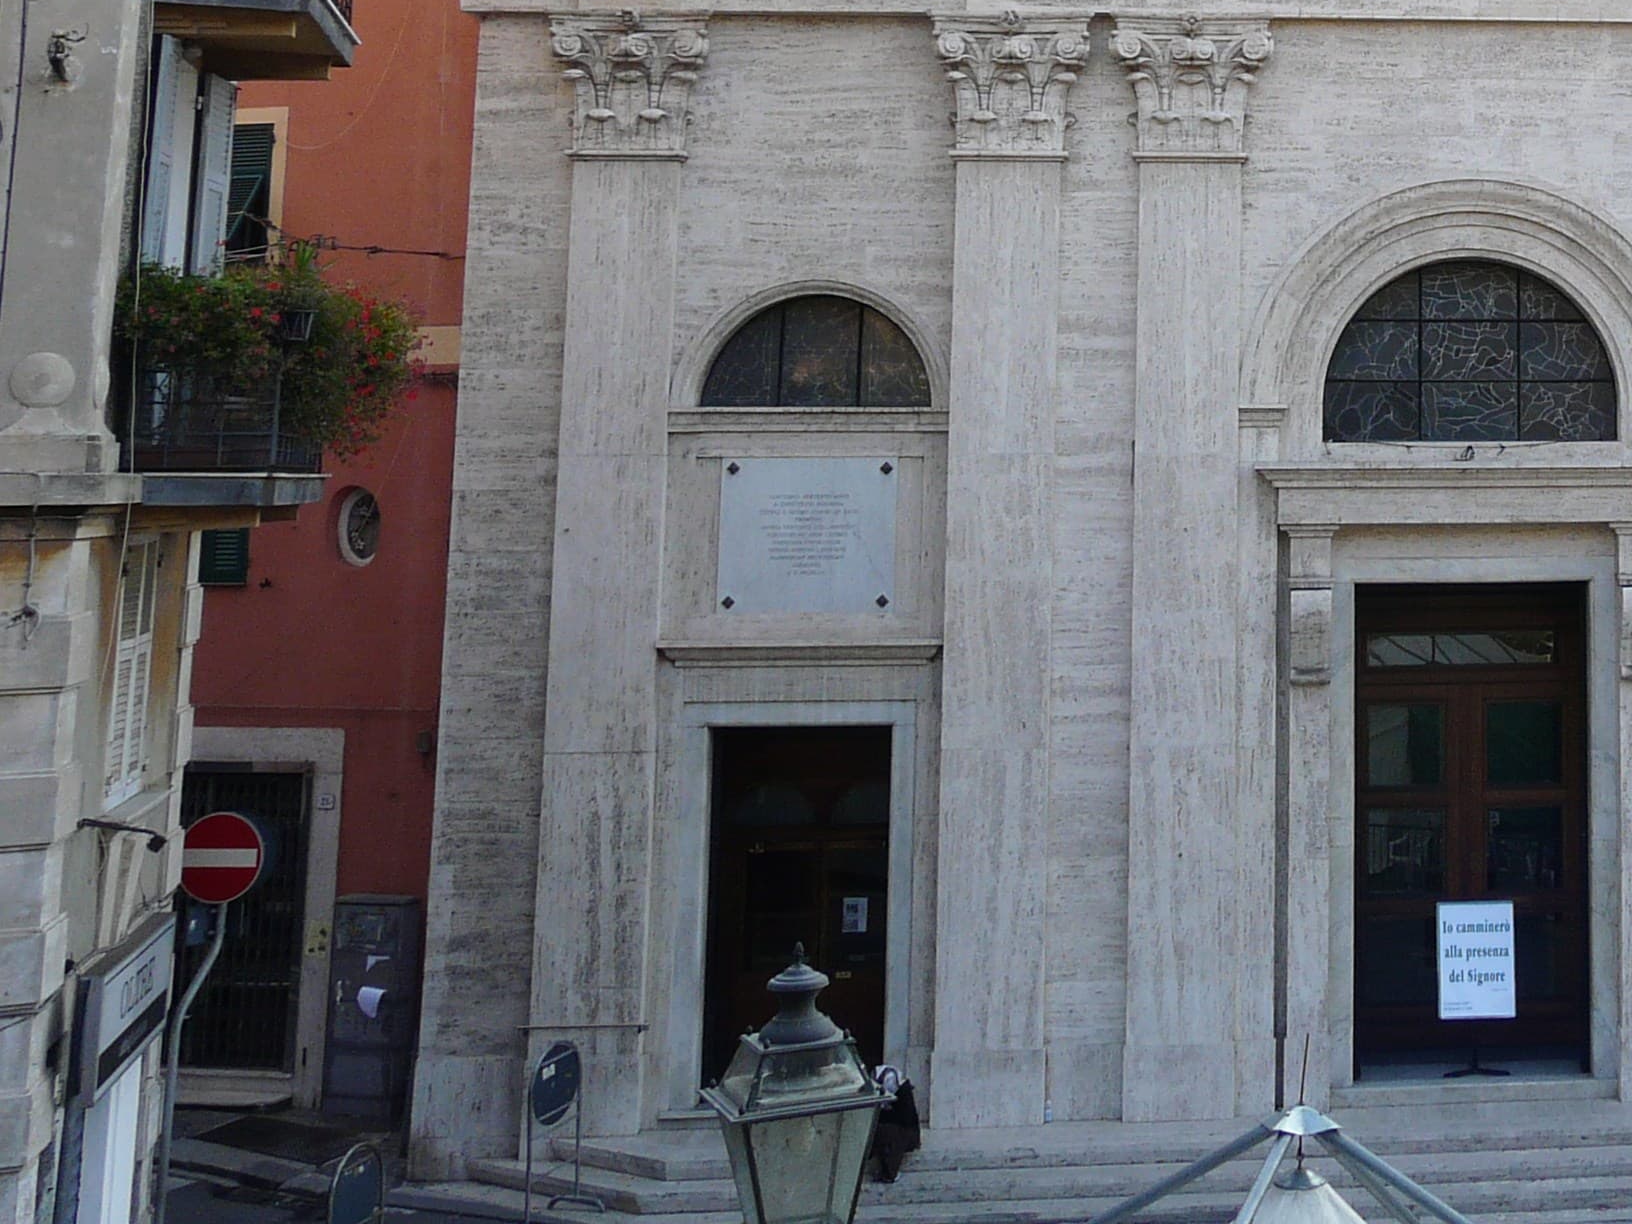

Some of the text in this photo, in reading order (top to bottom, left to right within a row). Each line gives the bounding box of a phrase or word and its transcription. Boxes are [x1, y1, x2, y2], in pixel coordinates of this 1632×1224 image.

[1442, 918, 1511, 934] Io camminerò
[1444, 944, 1509, 961] alla presenza
[1448, 967, 1505, 985] del Signore
